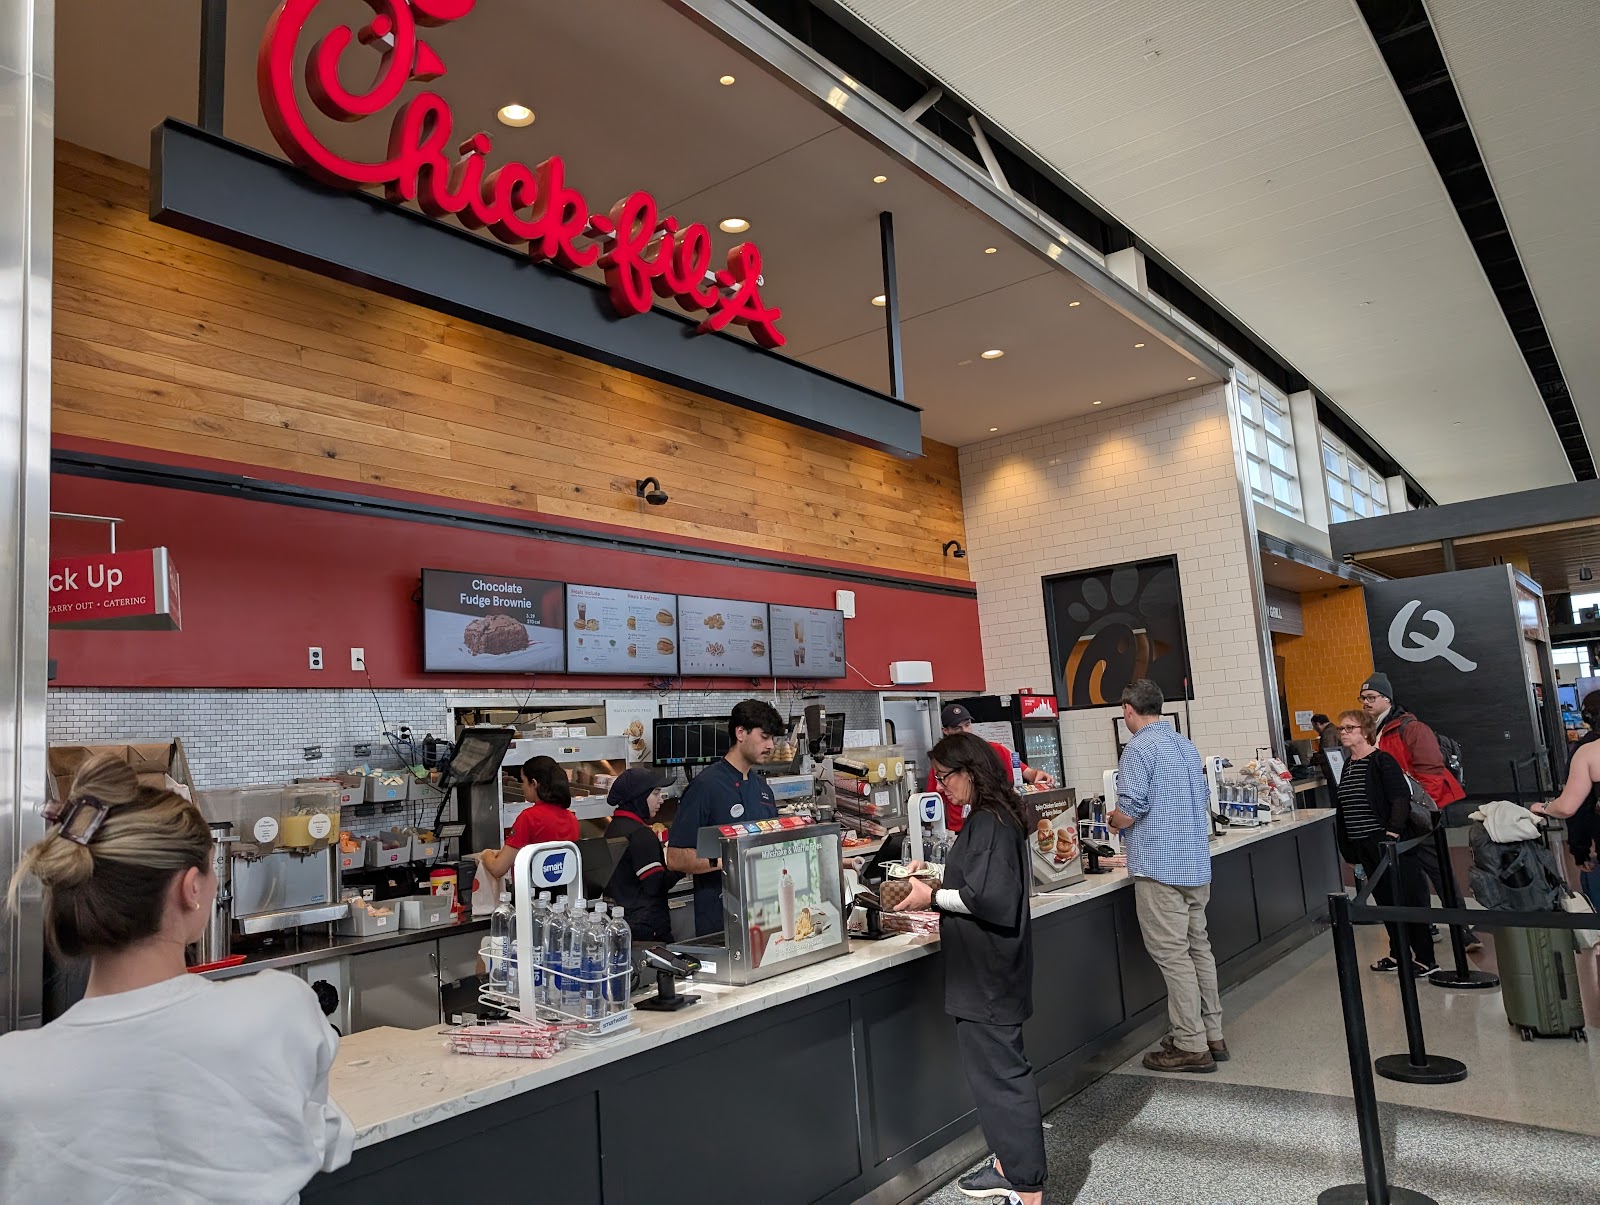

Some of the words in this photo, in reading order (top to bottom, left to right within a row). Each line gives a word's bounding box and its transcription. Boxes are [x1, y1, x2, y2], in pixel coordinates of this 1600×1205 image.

[257, 0, 787, 348] Chick-fil-A
[88, 564, 122, 592] Up
[472, 580, 522, 594] Chocolate
[75, 602, 94, 610] OUT
[103, 596, 146, 608] CATERING
[460, 593, 490, 608] Fudge
[493, 596, 532, 608] Brownie
[543, 862, 562, 873] smart
